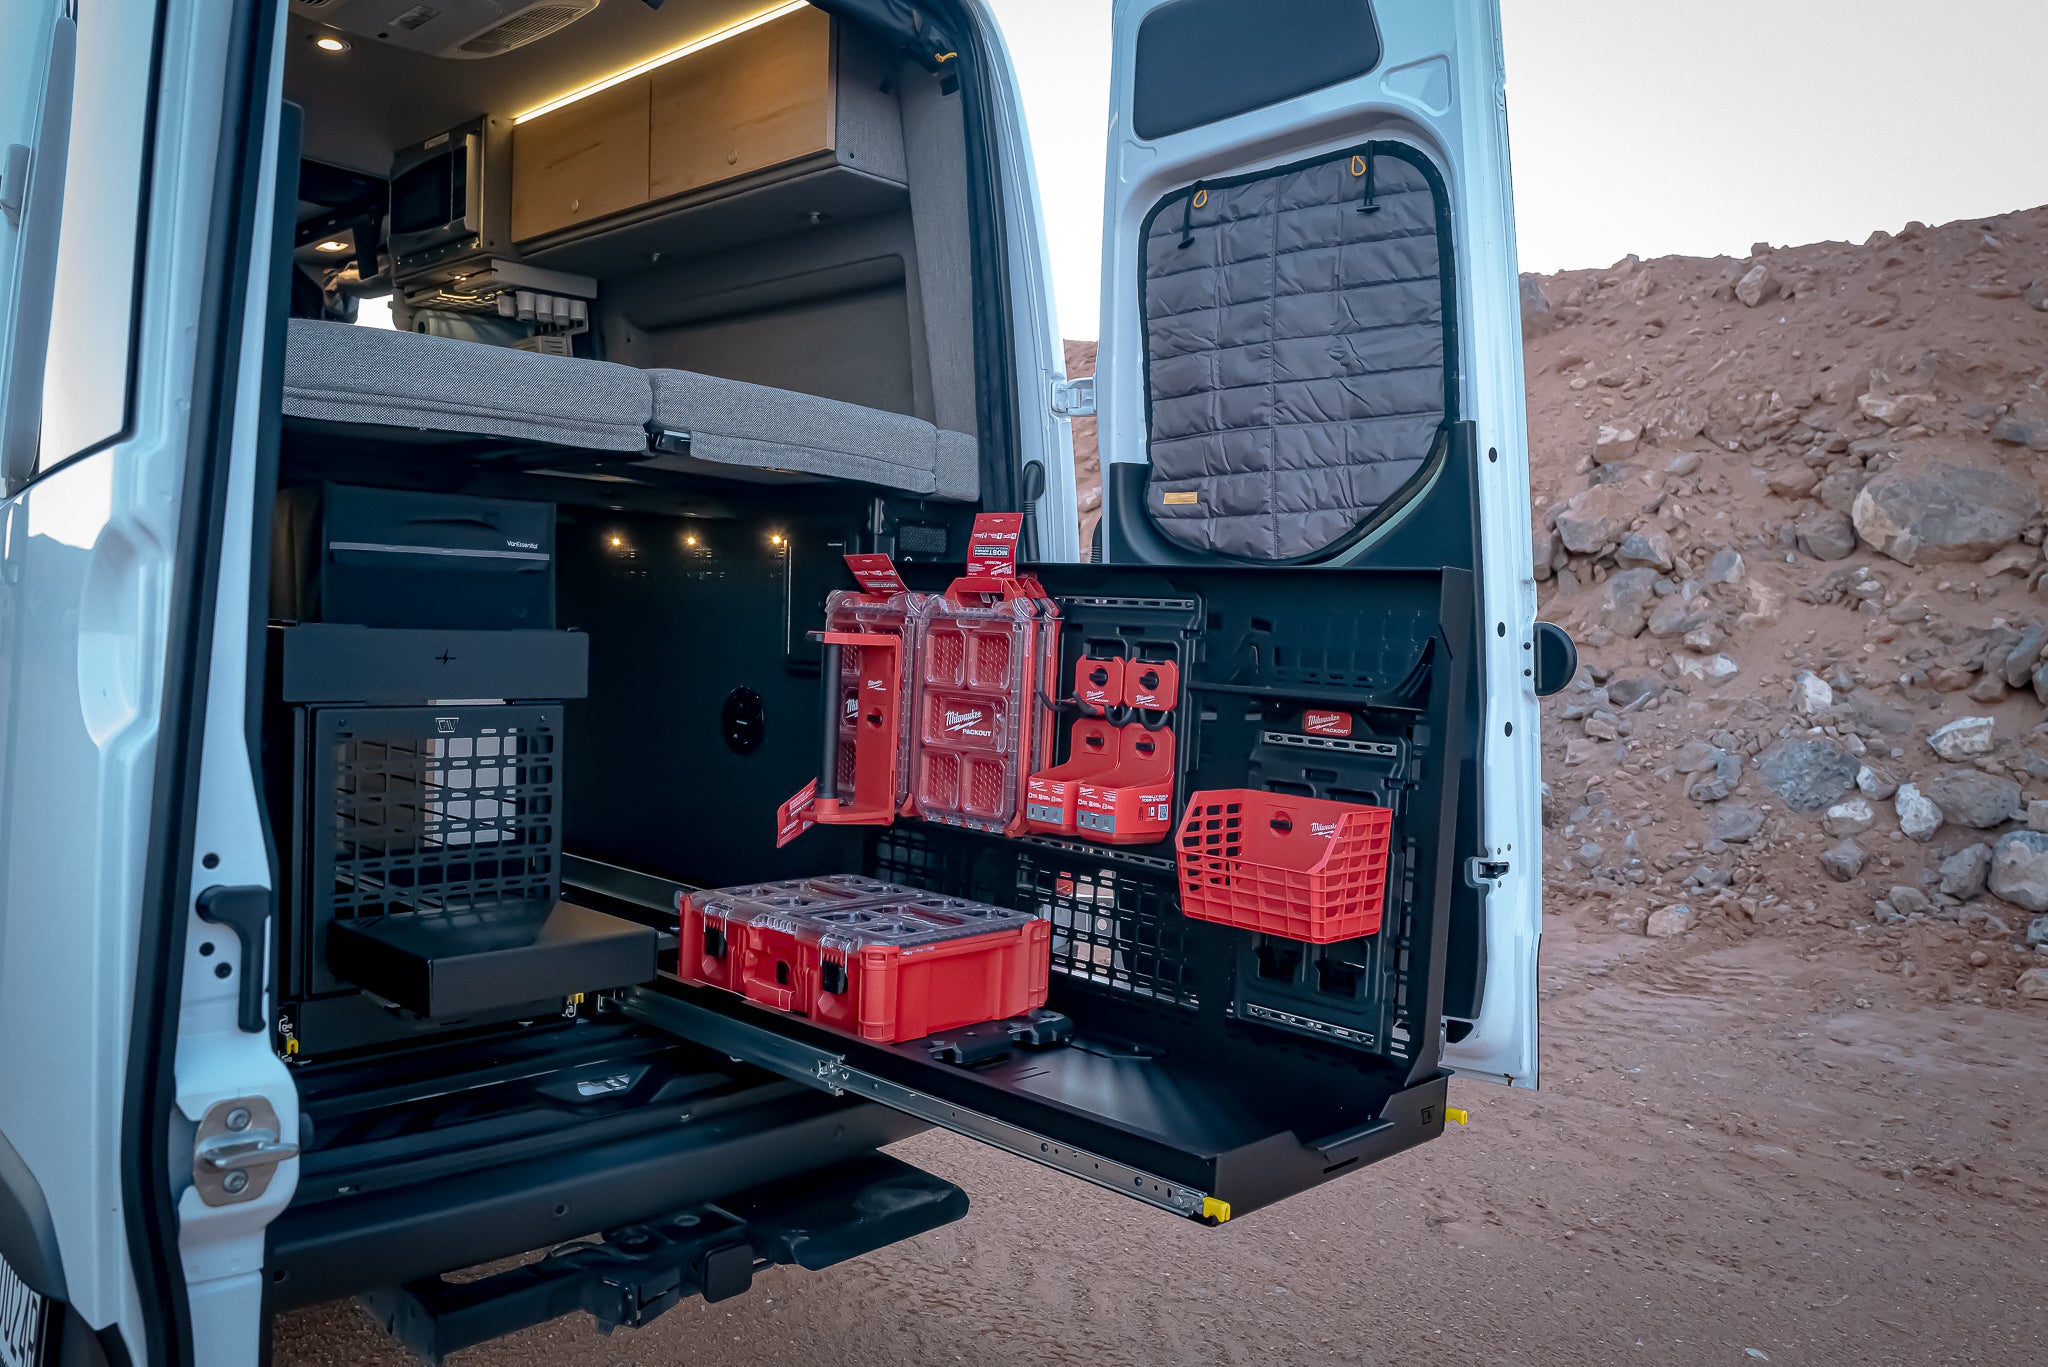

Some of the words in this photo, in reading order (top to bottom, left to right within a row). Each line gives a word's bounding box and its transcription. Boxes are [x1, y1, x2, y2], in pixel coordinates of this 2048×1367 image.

[945, 709, 982, 726] Milwaukee
[1308, 714, 1340, 726] Milwaukee
[962, 729, 991, 737] PACKOUT
